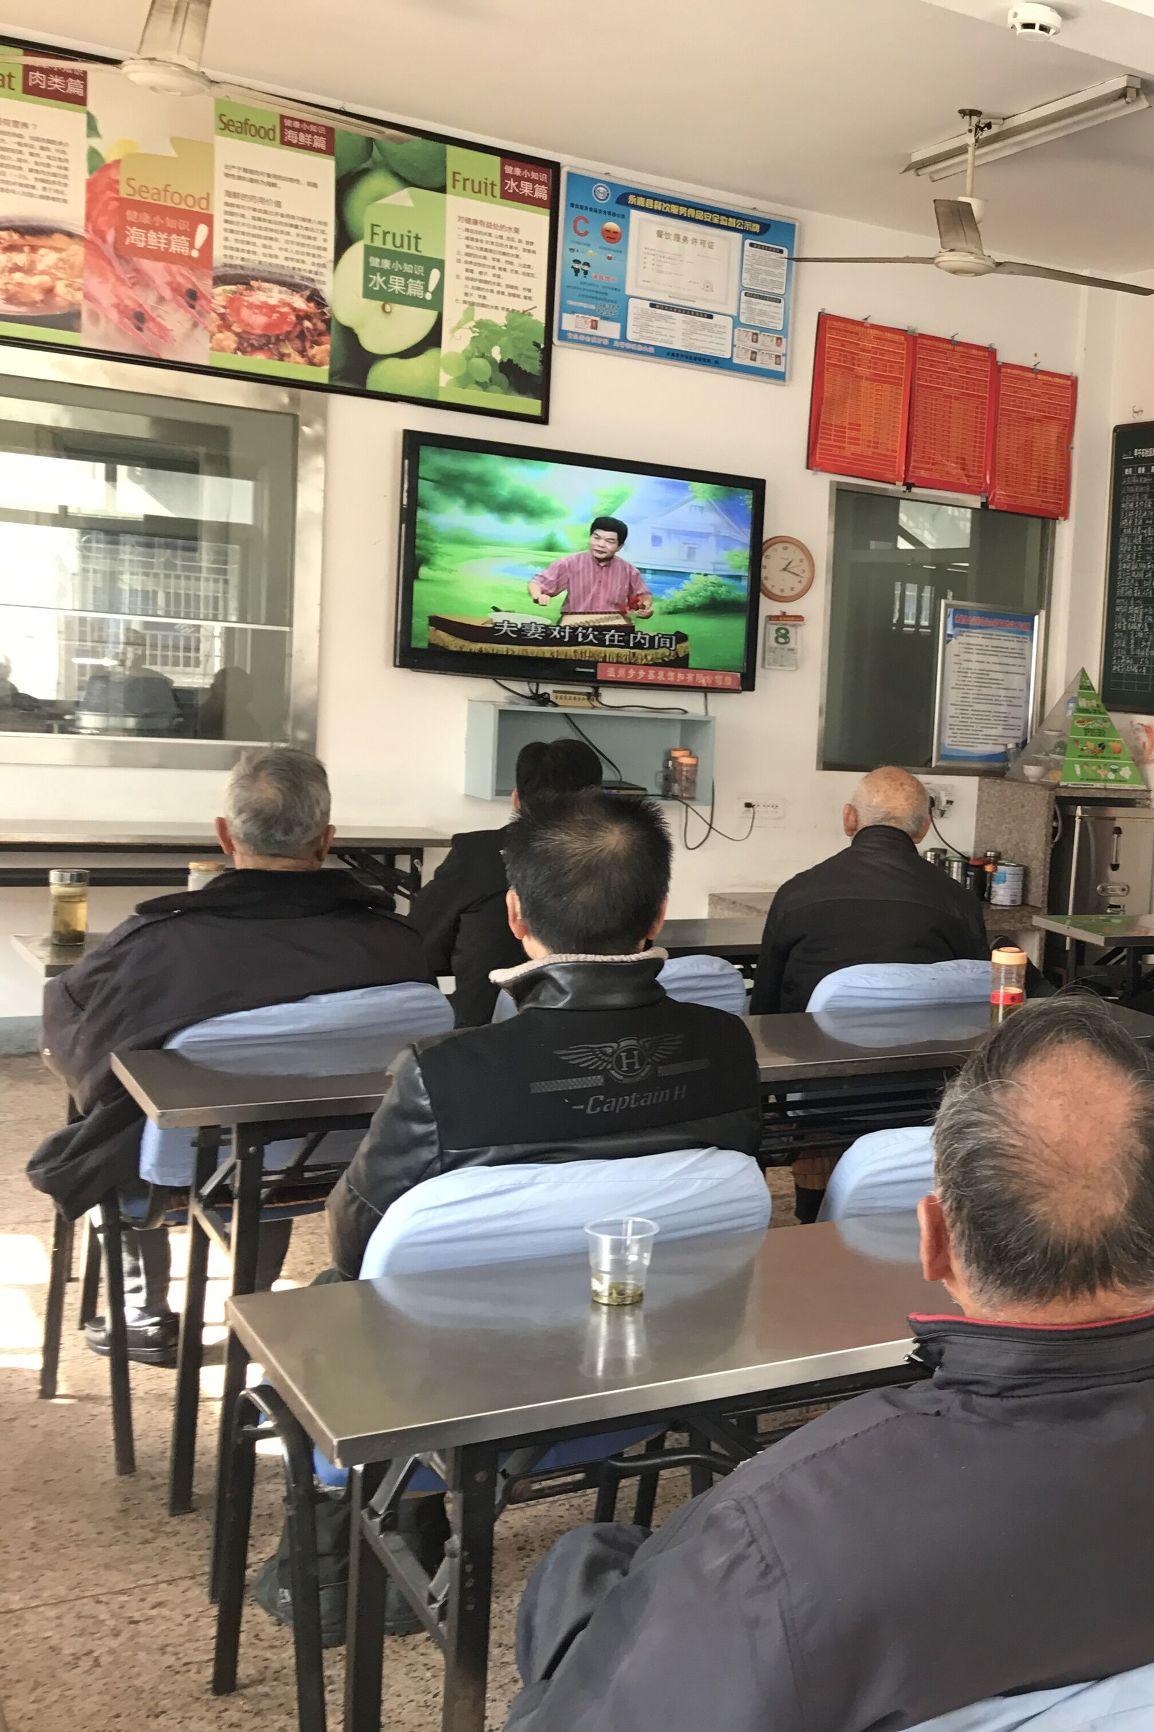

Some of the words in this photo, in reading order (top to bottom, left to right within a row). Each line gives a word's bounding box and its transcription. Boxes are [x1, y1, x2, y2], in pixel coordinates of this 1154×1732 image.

[28, 71, 85, 97] 肉类篇
[218, 113, 277, 142] Seafood
[283, 129, 328, 151] 海鲜篇
[452, 171, 497, 198] Fruit
[504, 165, 549, 182] 健康小知识
[126, 177, 211, 212] Seafood
[504, 178, 549, 201] 水果篇
[126, 209, 190, 232] 健康小知识
[370, 223, 423, 253] Fruit
[369, 256, 424, 276] 健康小知识
[494, 620, 677, 650] 夫妻对饮在内间
[774, 626, 791, 646] 8
